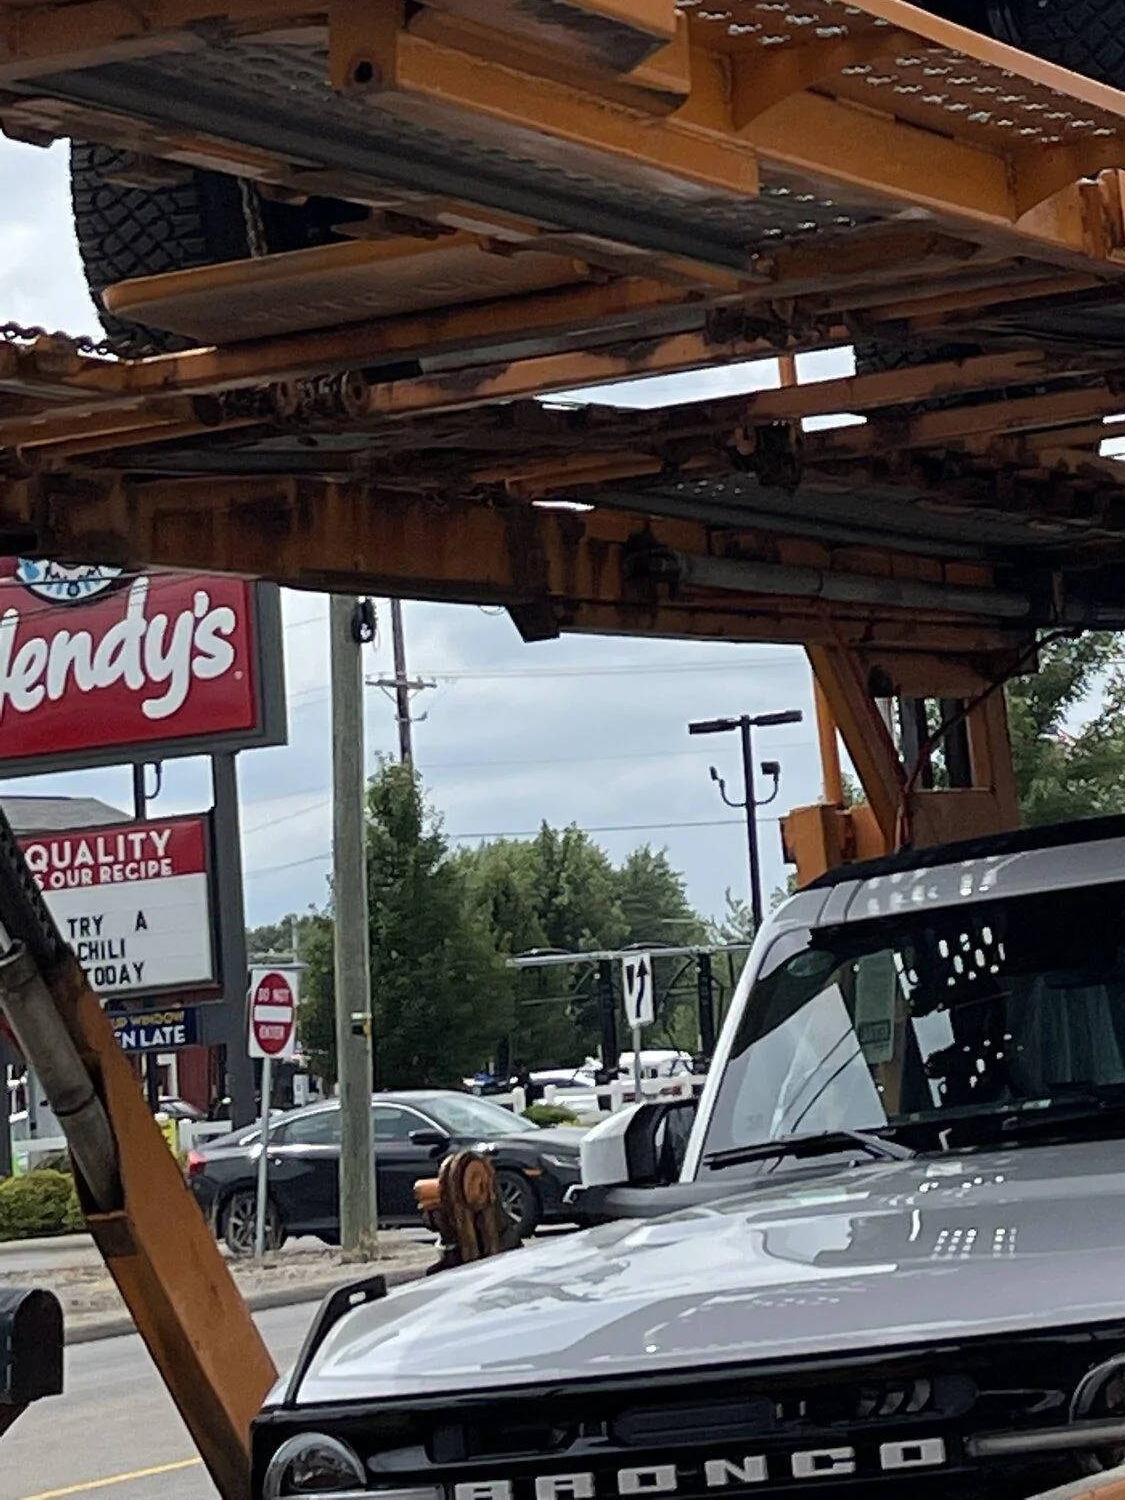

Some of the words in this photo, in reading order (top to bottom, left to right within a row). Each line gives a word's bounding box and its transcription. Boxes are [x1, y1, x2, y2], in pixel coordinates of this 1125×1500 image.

[0, 576, 236, 721] endy's
[24, 829, 171, 873] QUALITY
[50, 867, 93, 888] OUR
[100, 858, 173, 883] RECIPE
[67, 914, 104, 939] TRY
[135, 910, 148, 931] A
[77, 938, 126, 962] CHILI
[140, 1025, 186, 1047] LATE
[455, 1437, 946, 1500] BRONCO
